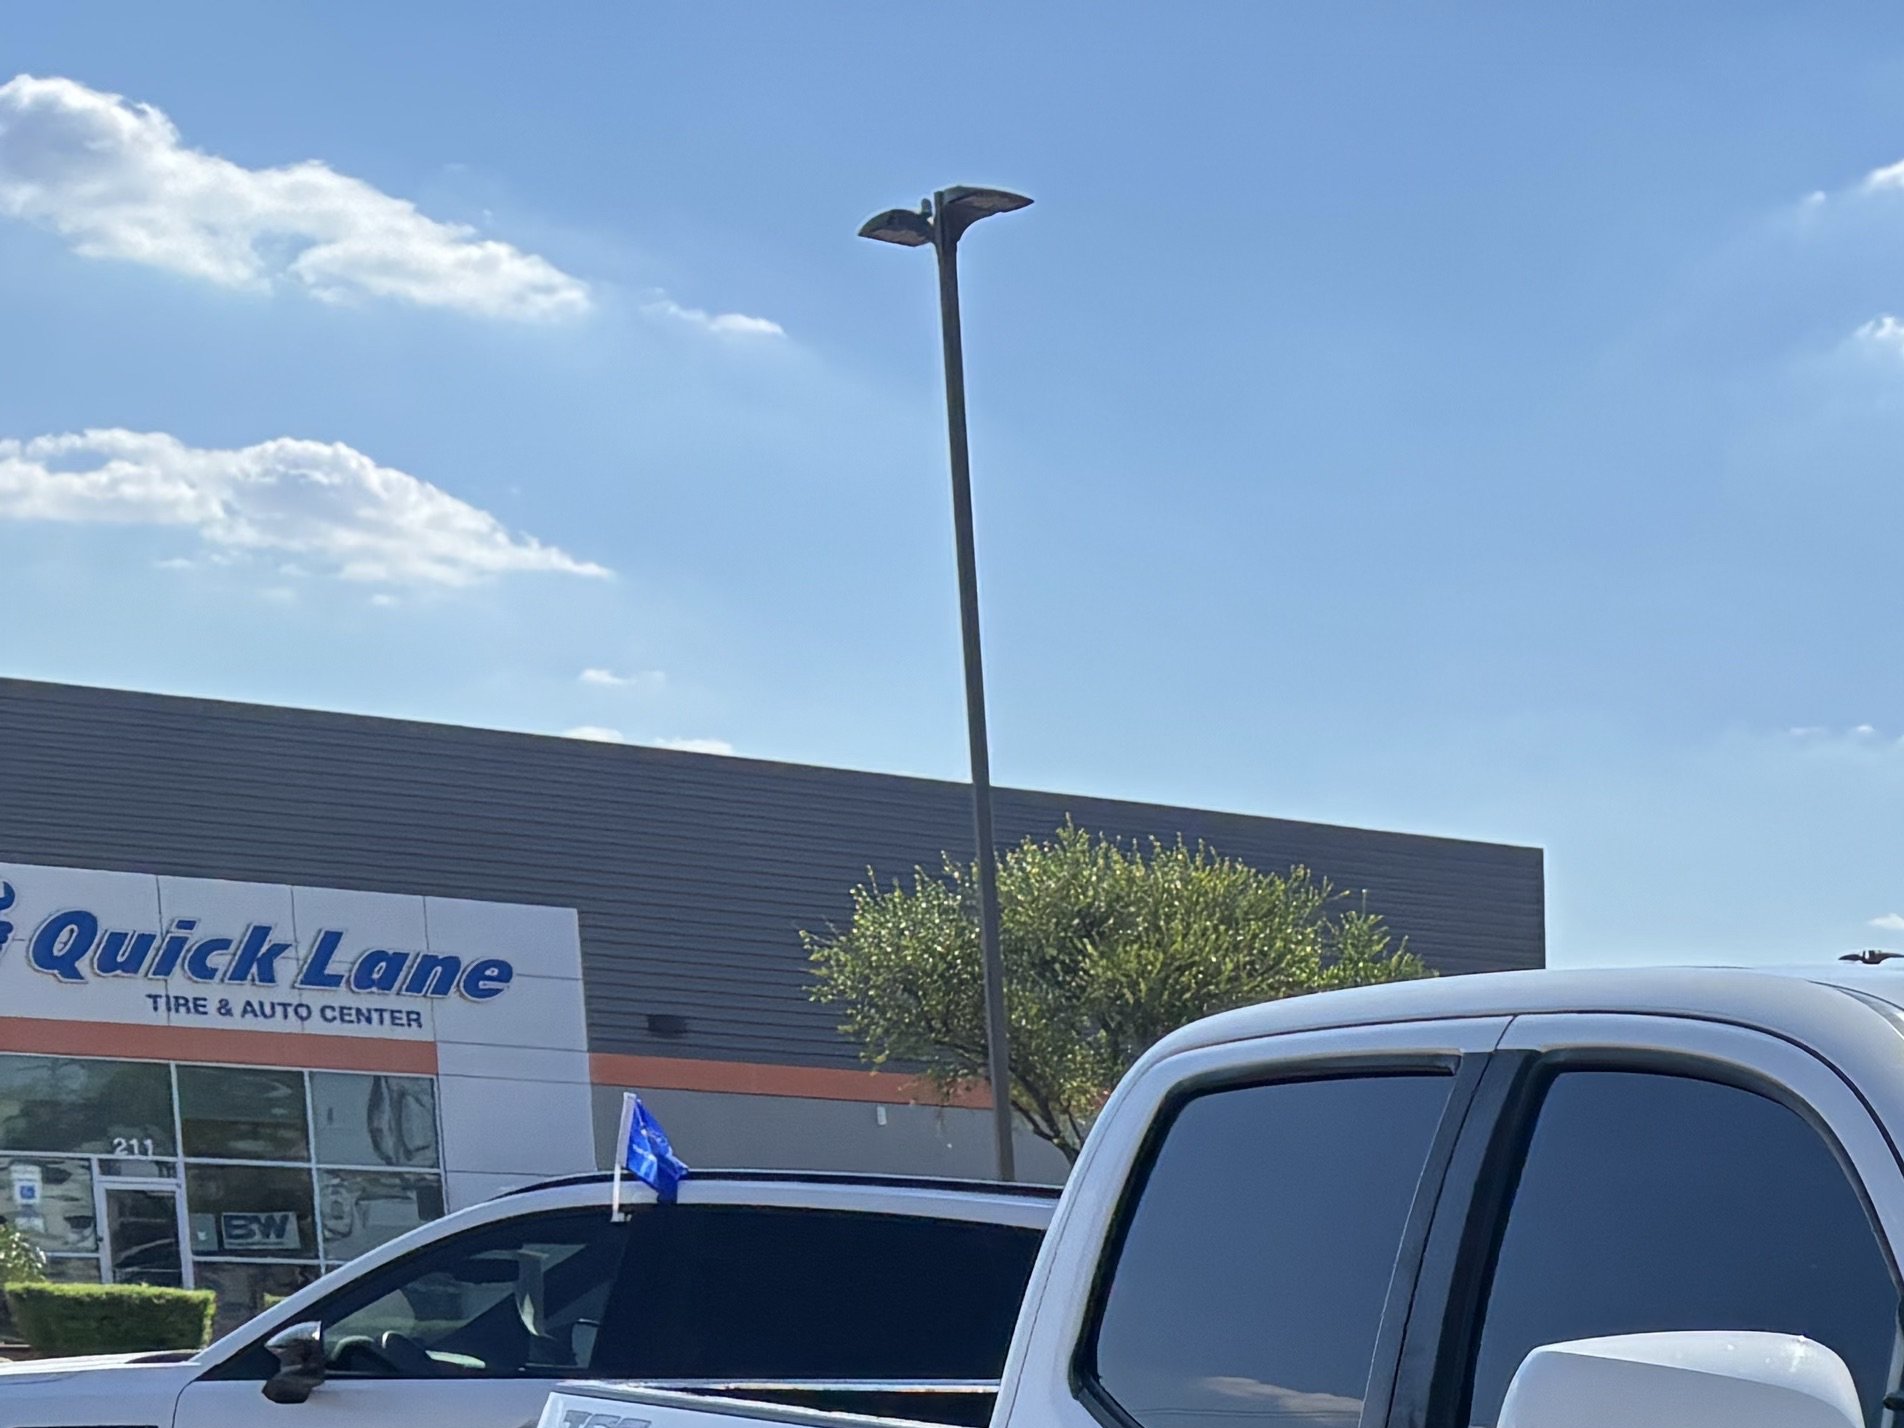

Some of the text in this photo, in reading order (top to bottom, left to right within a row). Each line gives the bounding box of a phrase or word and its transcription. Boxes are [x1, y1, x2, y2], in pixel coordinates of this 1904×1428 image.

[30, 909, 515, 1000] Quick Lane
[146, 994, 423, 1029] TIRE & AUTO CENTER
[113, 1138, 154, 1156] 211
